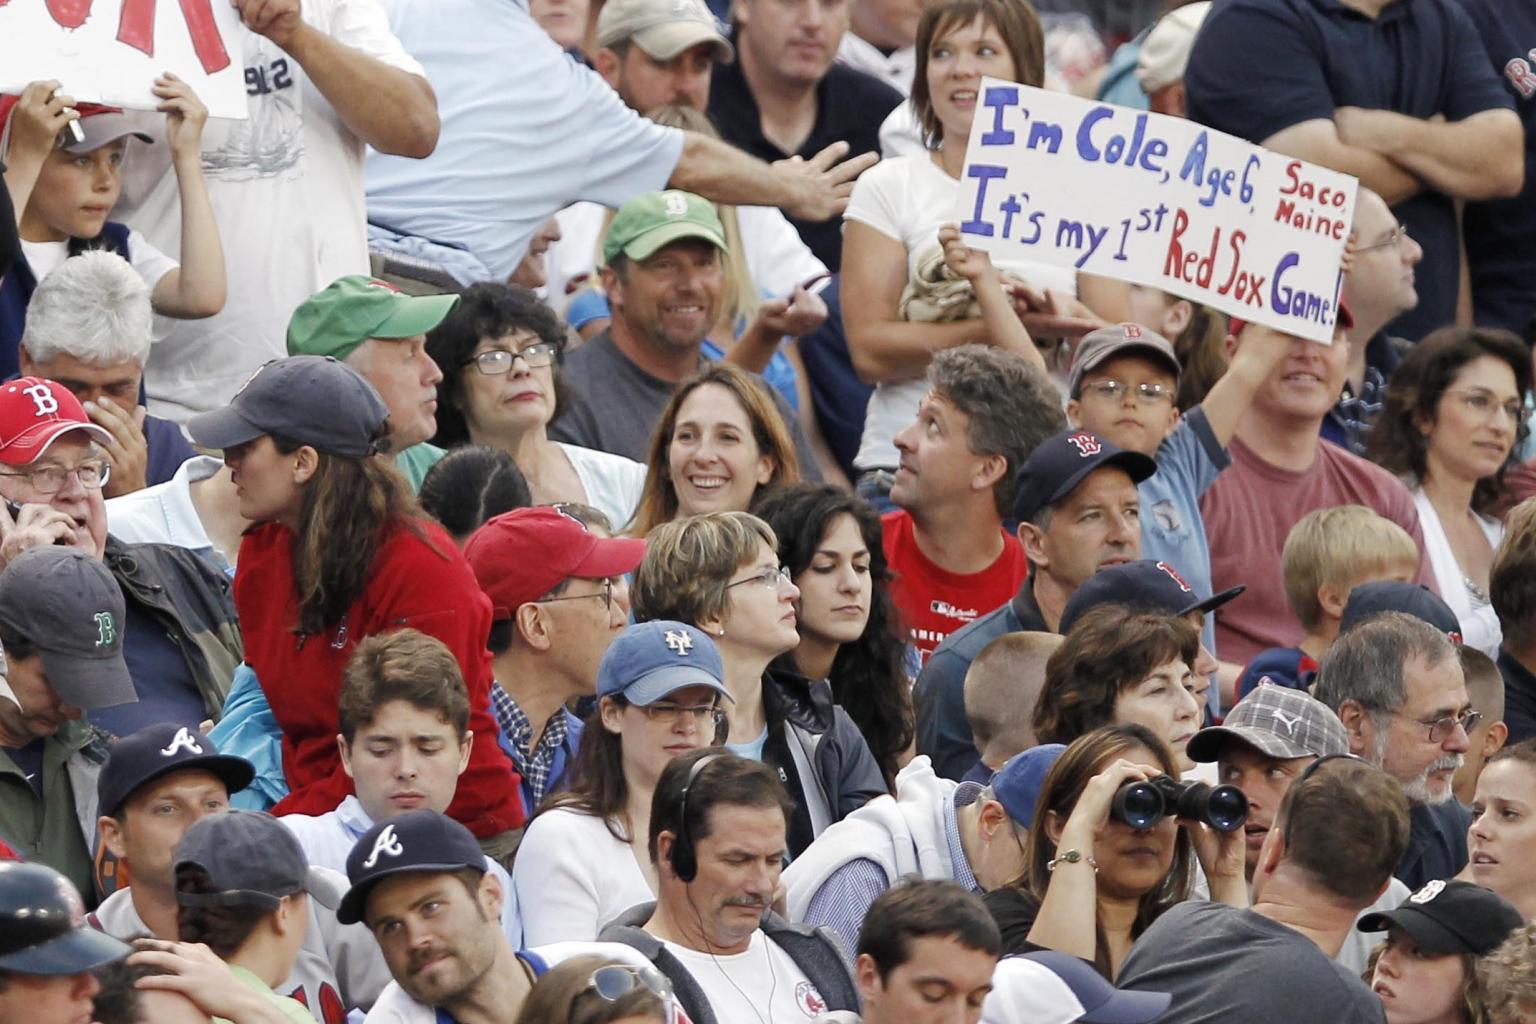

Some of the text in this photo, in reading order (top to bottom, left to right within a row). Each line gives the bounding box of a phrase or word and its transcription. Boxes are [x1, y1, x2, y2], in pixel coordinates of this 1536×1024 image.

[981, 86, 1063, 154] I'm
[1076, 106, 1170, 183] Cole,
[1179, 130, 1236, 206] Age
[662, 191, 688, 216] B
[1274, 198, 1346, 240] Maine
[960, 164, 1343, 326] It's my 1st Red Sox Game!
[23, 384, 58, 416] B
[1067, 431, 1101, 457] B
[93, 611, 117, 647] B
[664, 629, 693, 657] NY
[160, 727, 203, 757] A
[362, 824, 404, 869] A
